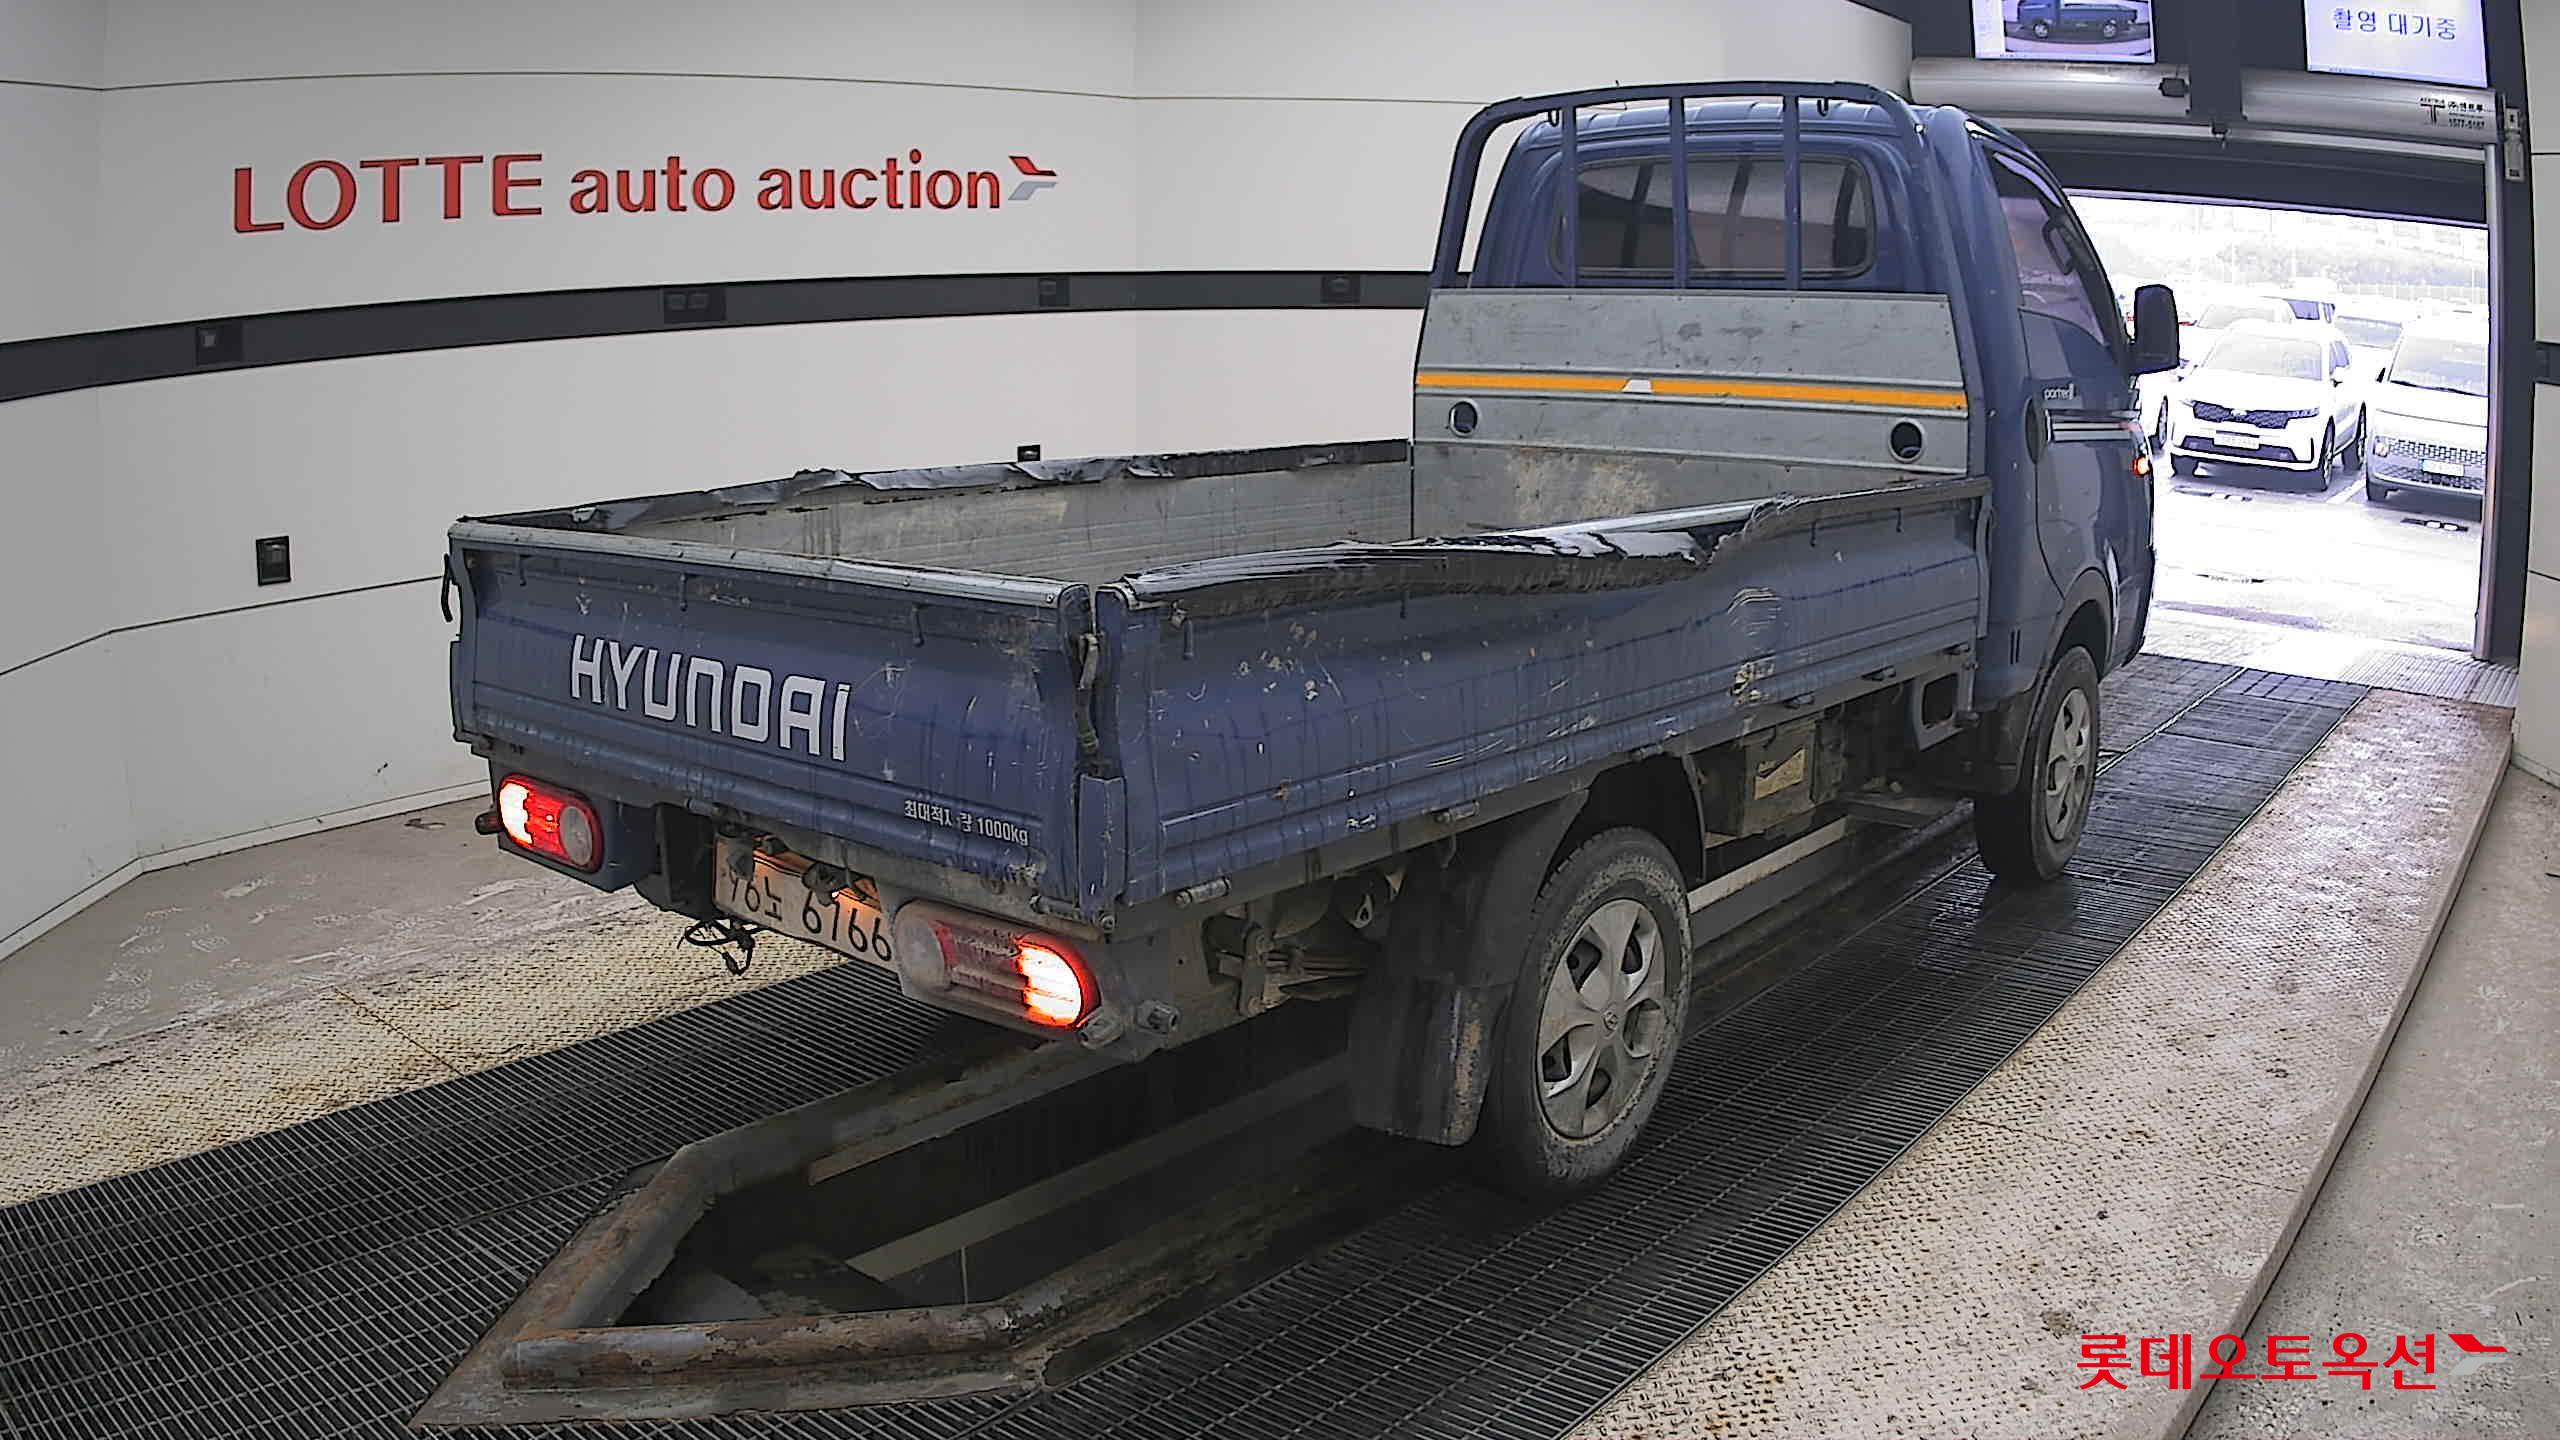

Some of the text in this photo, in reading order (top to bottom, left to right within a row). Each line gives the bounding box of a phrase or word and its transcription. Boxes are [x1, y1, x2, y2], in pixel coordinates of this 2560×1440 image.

[2333, 8, 2456, 40] 촬영 대기중
[234, 148, 1001, 233] LOTTE auto auction
[570, 633, 852, 762] HYUNDAI
